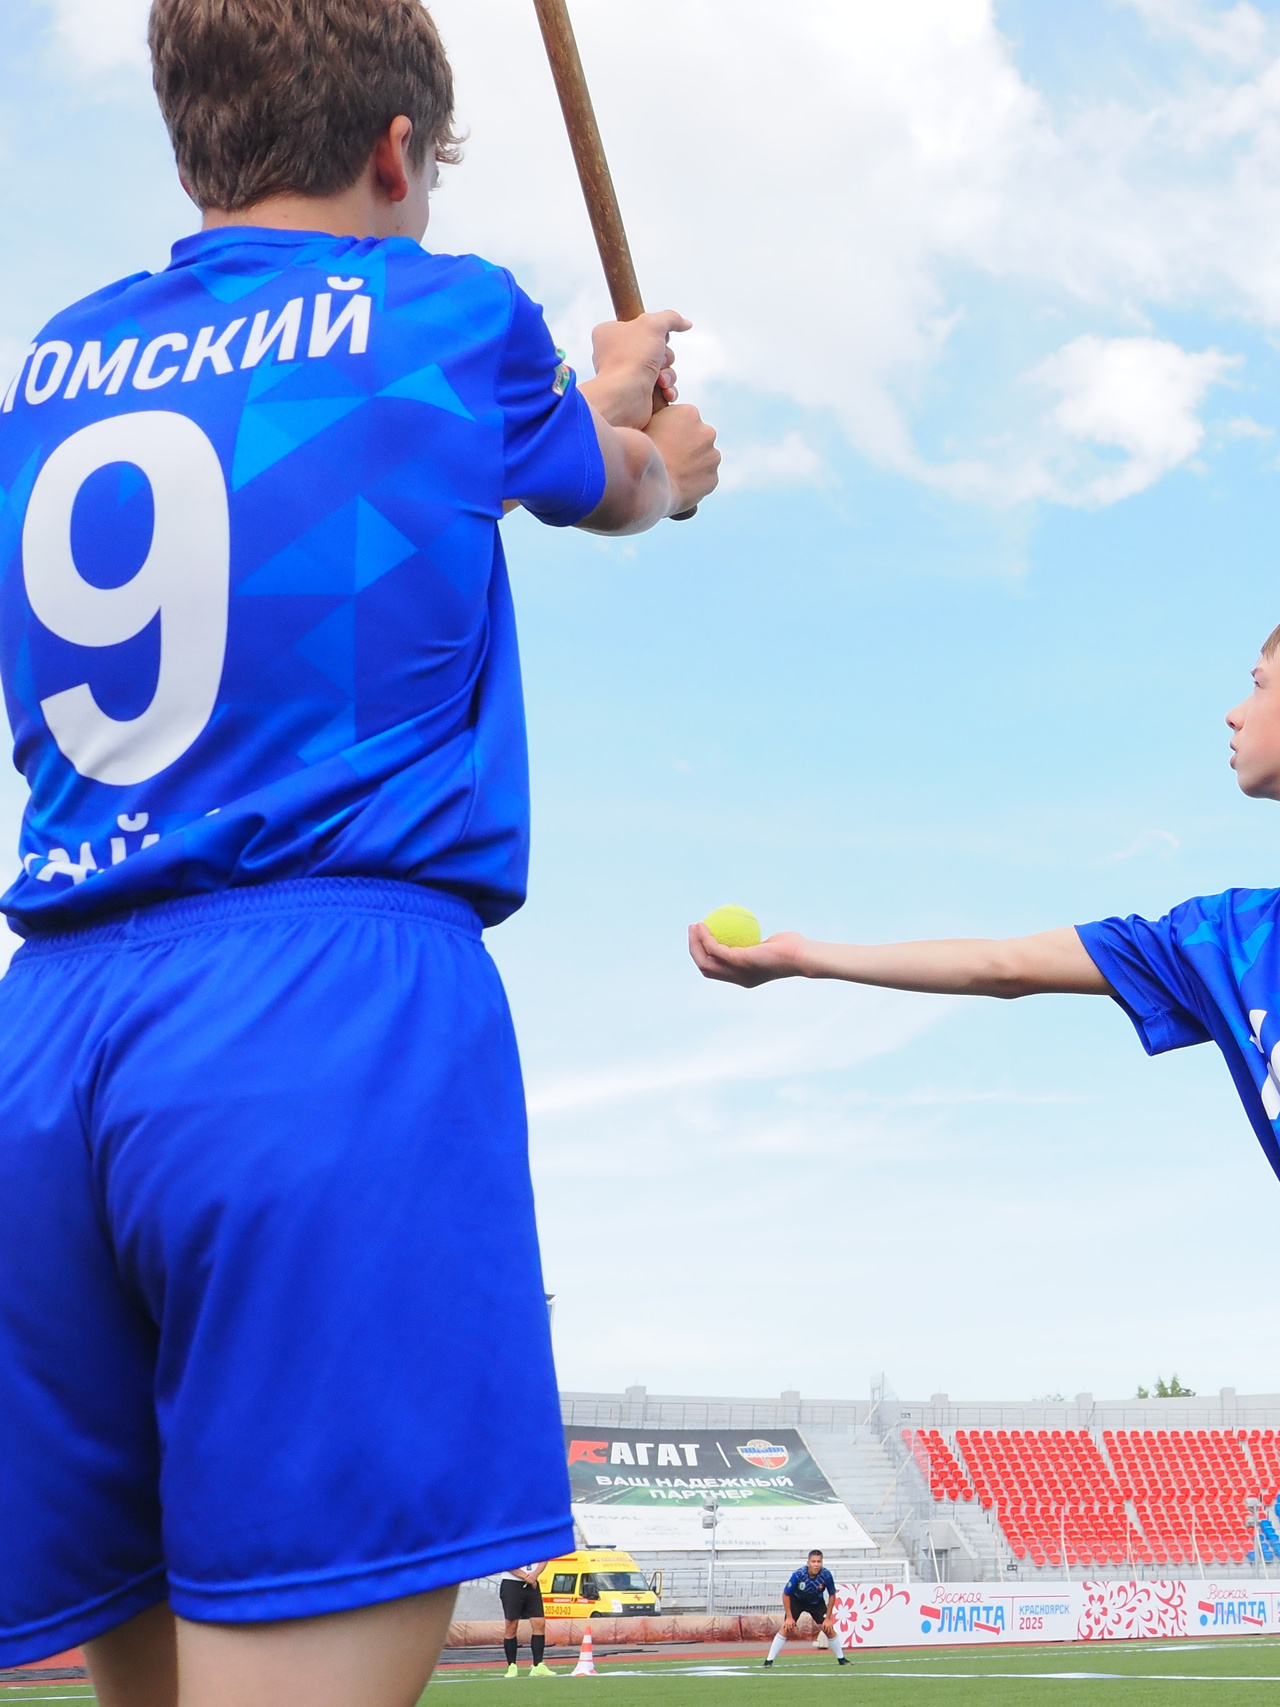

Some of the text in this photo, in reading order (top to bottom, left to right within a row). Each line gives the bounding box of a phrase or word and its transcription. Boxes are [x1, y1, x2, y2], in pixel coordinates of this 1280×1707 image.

[22, 410, 230, 786] 9
[595, 1475, 794, 1488] ВАШ НАДЕЖНЫЙ
[649, 1489, 754, 1500] ПАРТНЕР
[931, 1586, 984, 1604] Русская
[1207, 1584, 1248, 1600] Русская
[544, 1605, 571, 1615] 203-03-03
[1019, 1604, 1070, 1616] КРАСНОЯРСК
[1213, 1601, 1267, 1626] ЛАПТА
[937, 1605, 1005, 1633] ЛАПТА
[1019, 1617, 1044, 1630] 2025
